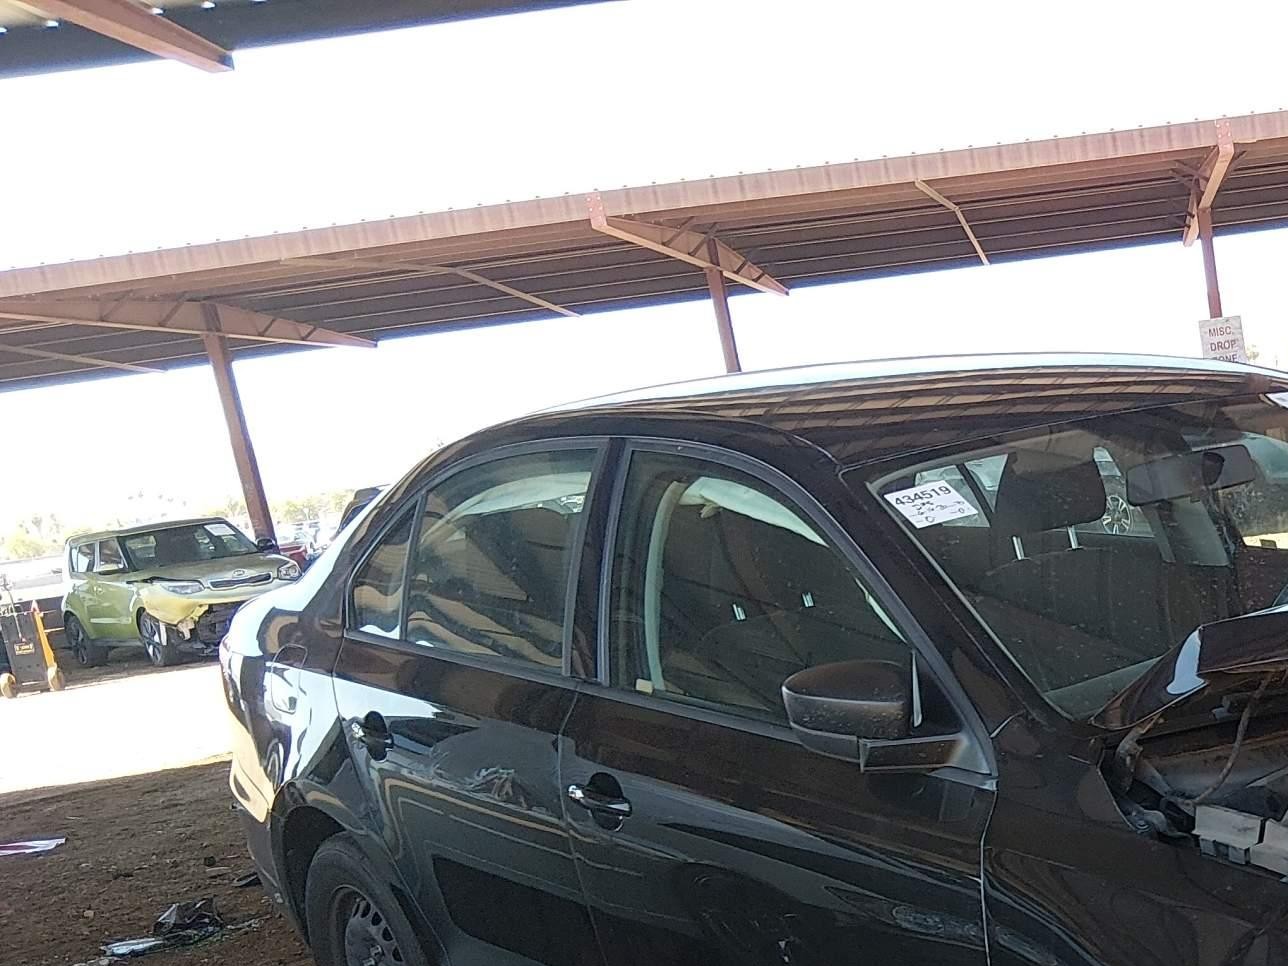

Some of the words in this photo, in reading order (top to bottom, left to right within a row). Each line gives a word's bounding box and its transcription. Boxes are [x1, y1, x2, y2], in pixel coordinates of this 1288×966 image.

[1210, 339, 1236, 352] DROP
[1213, 353, 1238, 363] ONE
[895, 485, 952, 506] 434519
